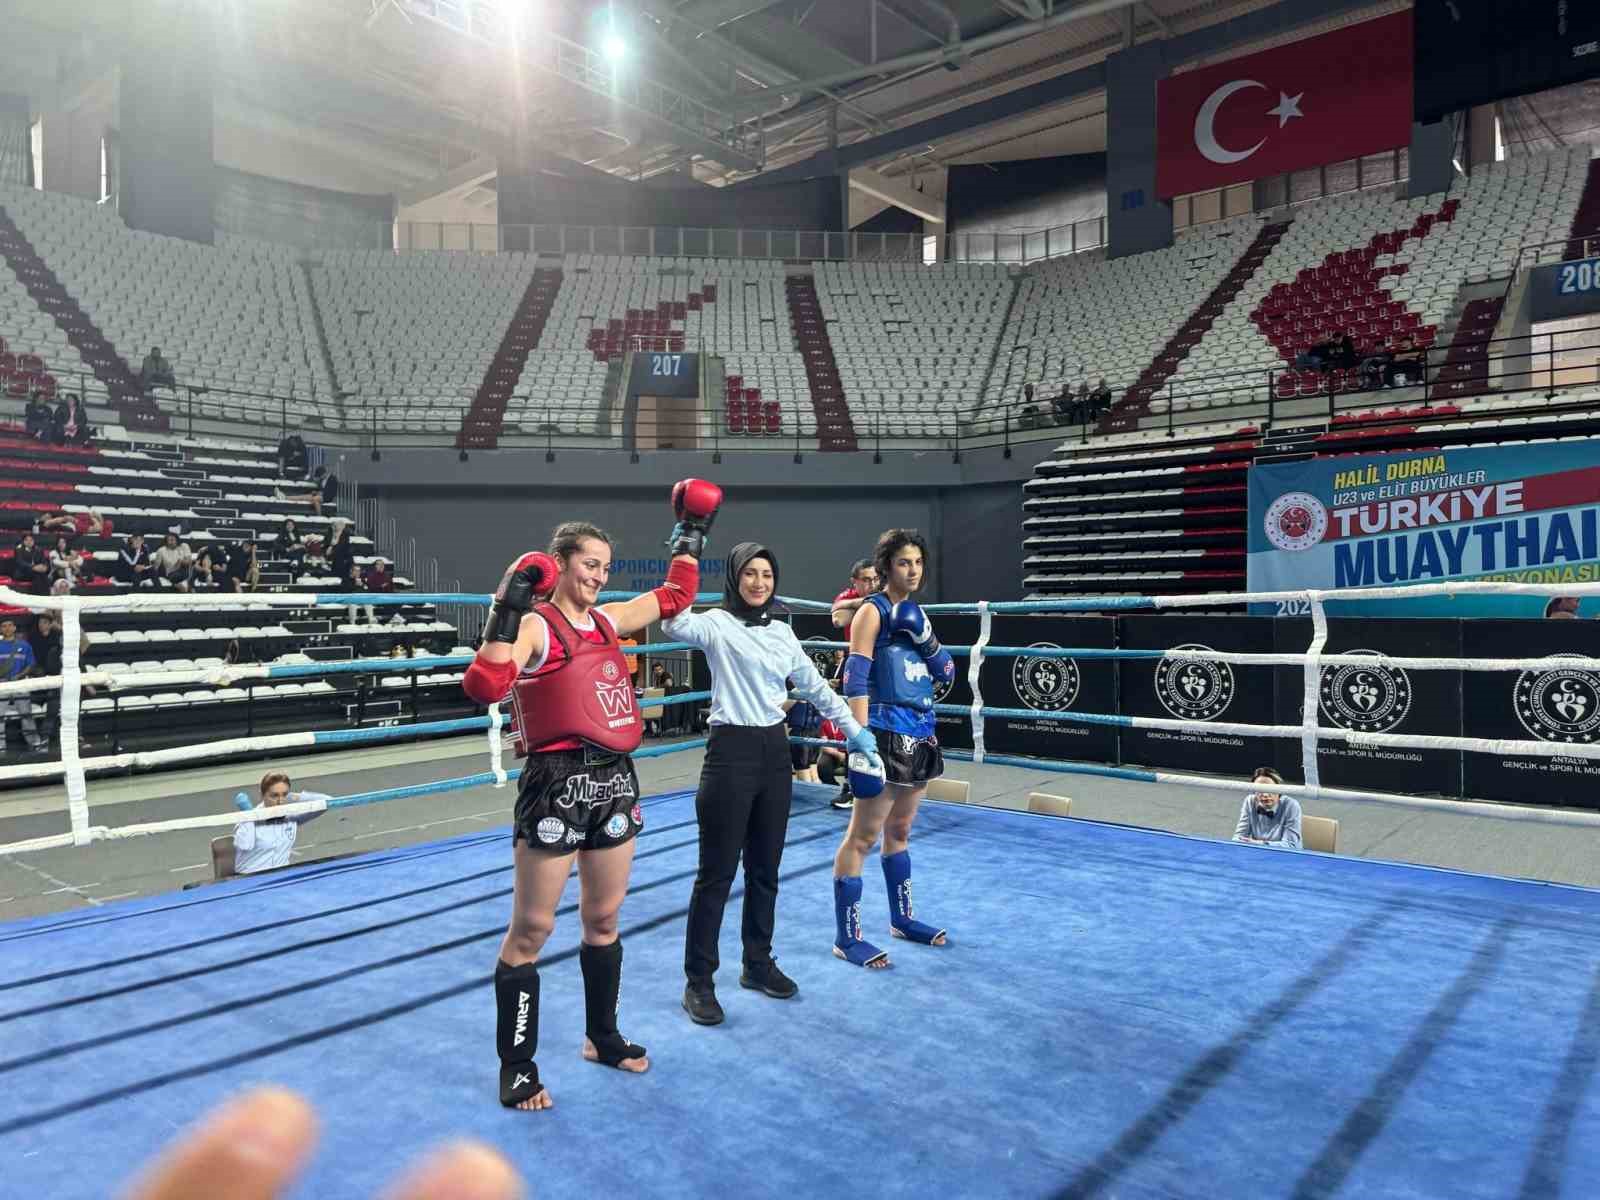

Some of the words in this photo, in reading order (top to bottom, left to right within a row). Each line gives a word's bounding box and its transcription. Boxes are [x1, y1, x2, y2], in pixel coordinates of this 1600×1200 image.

[652, 355, 681, 376] 207
[1333, 490, 1358, 506] U23
[1360, 490, 1375, 501] ve
[1379, 481, 1409, 499] ELİT
[1410, 470, 1486, 494] BÜYÜKLER
[1334, 464, 1380, 490] HALİL
[1386, 455, 1446, 481] DURNA
[1333, 481, 1524, 538] TÜRKİYE
[1333, 509, 1598, 588] MUAYTHAI
[1550, 764, 1573, 772] SPOR
[1551, 756, 1588, 765] ANTALYA
[513, 991, 531, 1047] ARIMA
